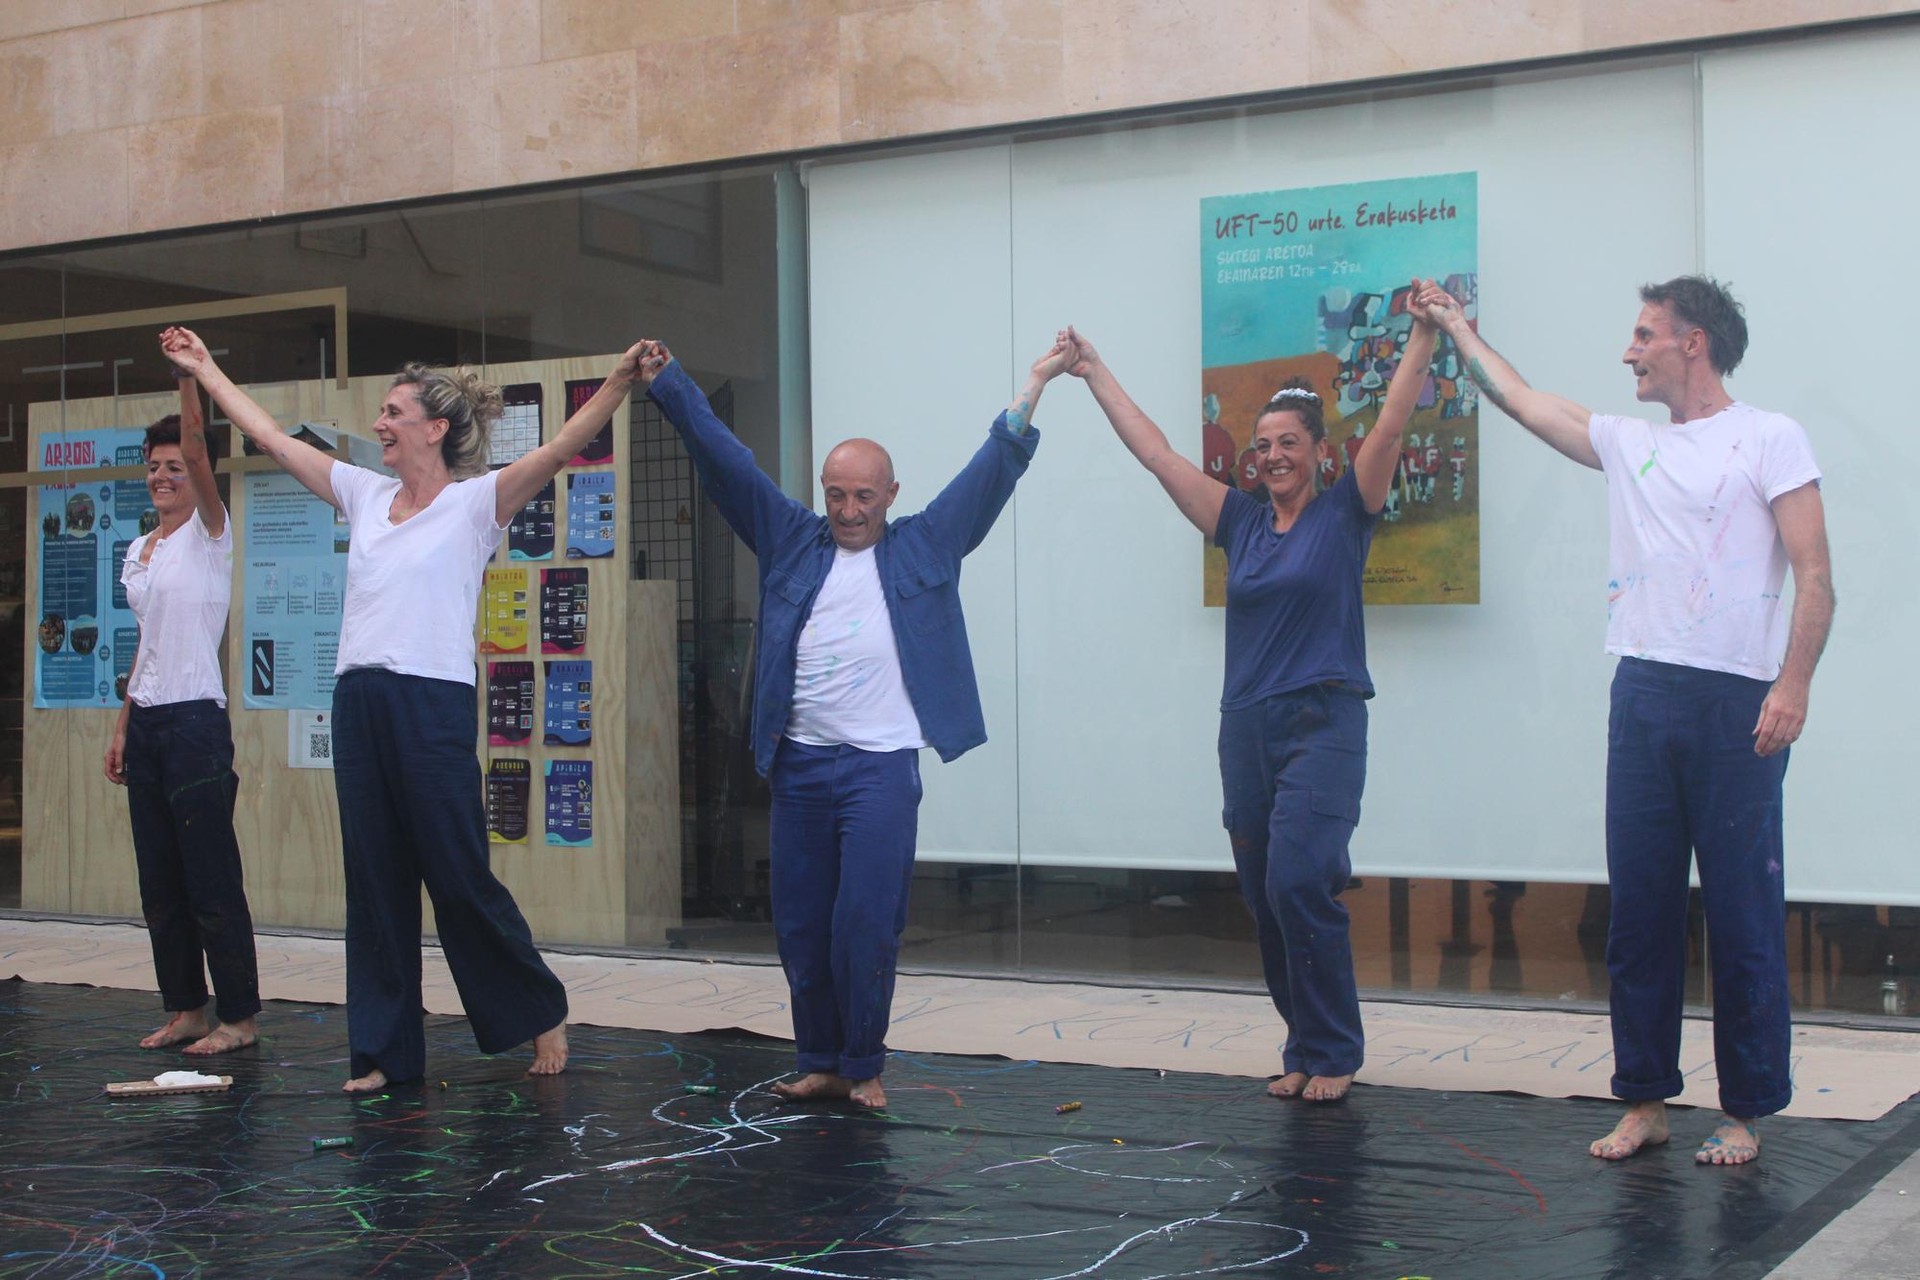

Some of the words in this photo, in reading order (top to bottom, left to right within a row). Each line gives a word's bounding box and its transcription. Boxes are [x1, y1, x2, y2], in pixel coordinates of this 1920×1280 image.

[1215, 210, 1298, 239] UFT-50
[1308, 208, 1345, 232] urte.
[1355, 198, 1456, 228] Erakusketa
[1217, 247, 1260, 264] SUTEGI
[1266, 244, 1313, 260] ARETOA
